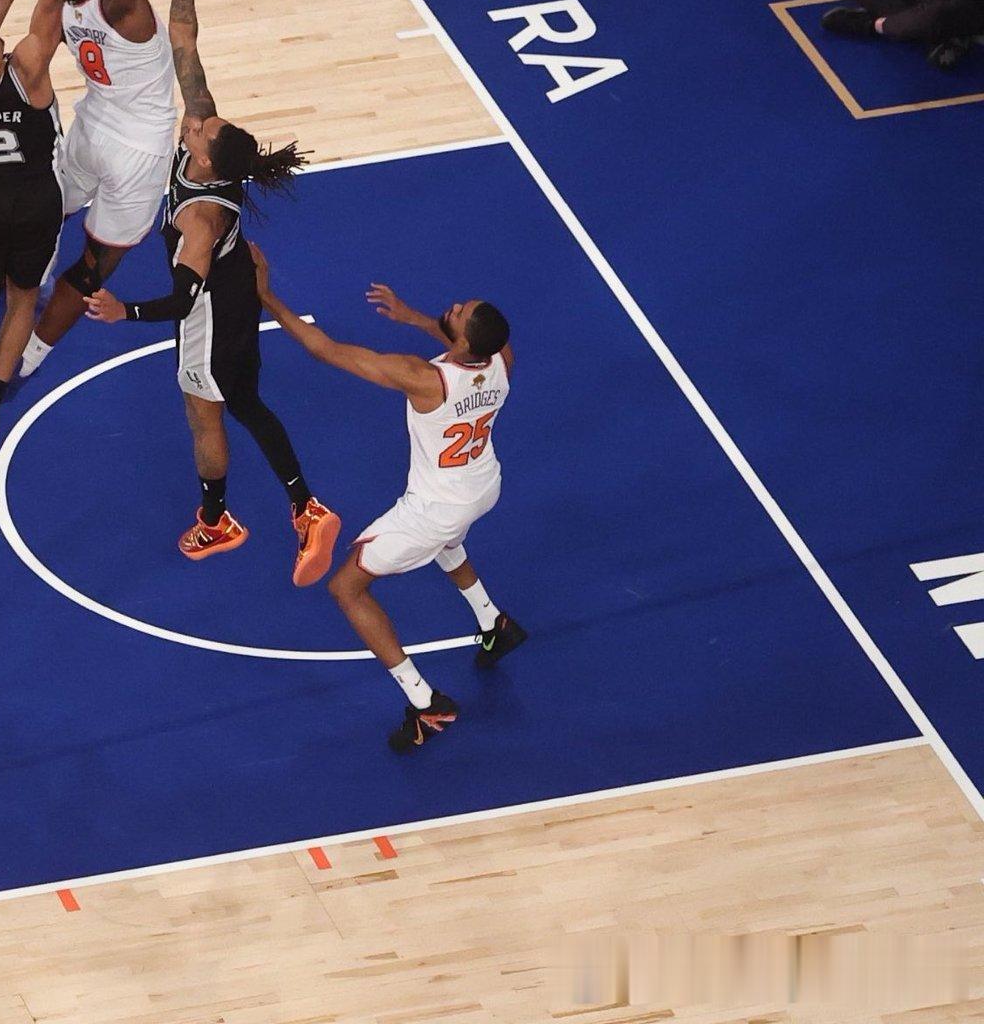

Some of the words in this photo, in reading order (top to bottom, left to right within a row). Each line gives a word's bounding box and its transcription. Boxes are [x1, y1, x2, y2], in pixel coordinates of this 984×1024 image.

[79, 39, 112, 87] 8
[454, 389, 501, 417] BRIDGES
[438, 409, 498, 468] 25
